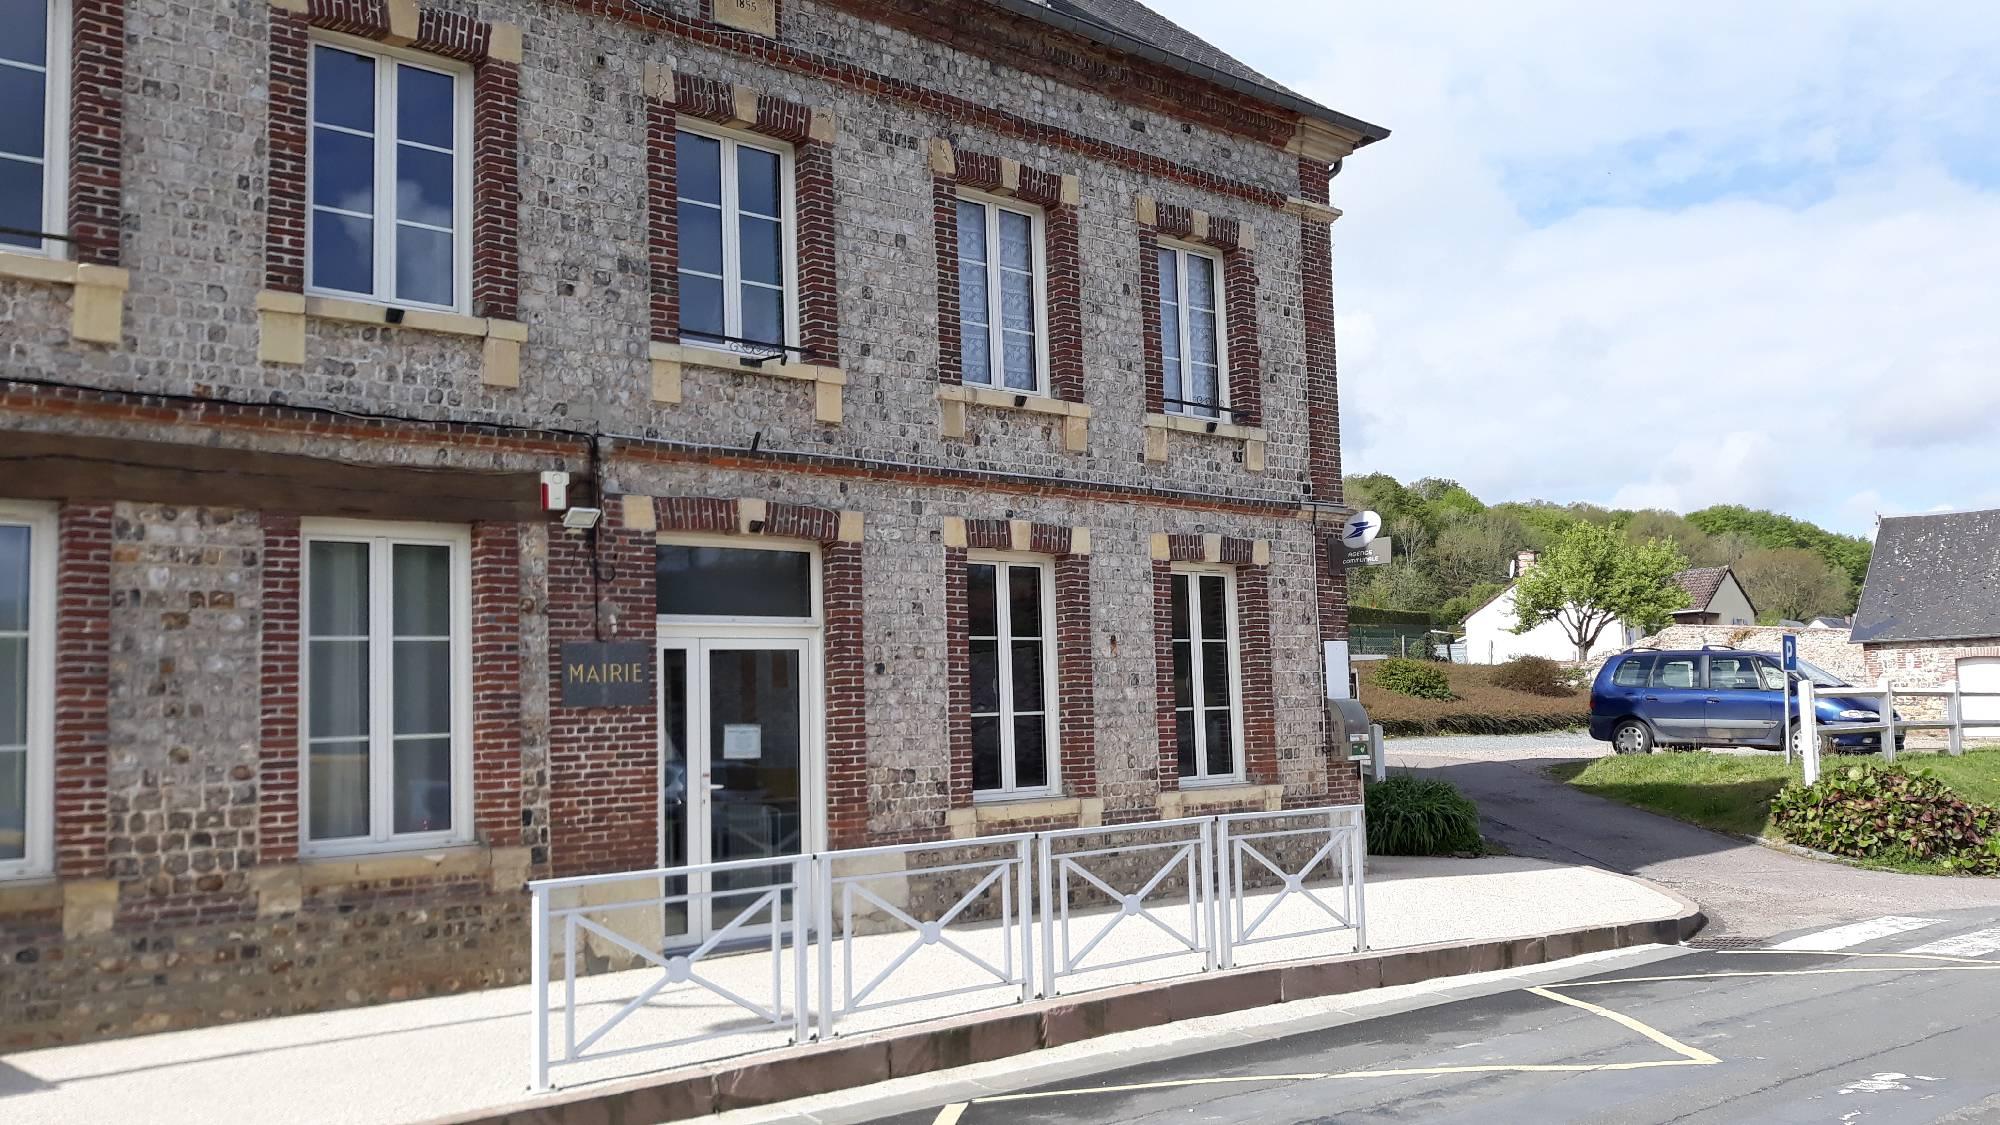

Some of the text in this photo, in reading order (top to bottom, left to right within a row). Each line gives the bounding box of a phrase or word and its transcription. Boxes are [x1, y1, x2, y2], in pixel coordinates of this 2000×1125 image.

[736, 0, 757, 12] 1855
[1786, 641, 1792, 664] P
[569, 663, 643, 683] MAIRIE
